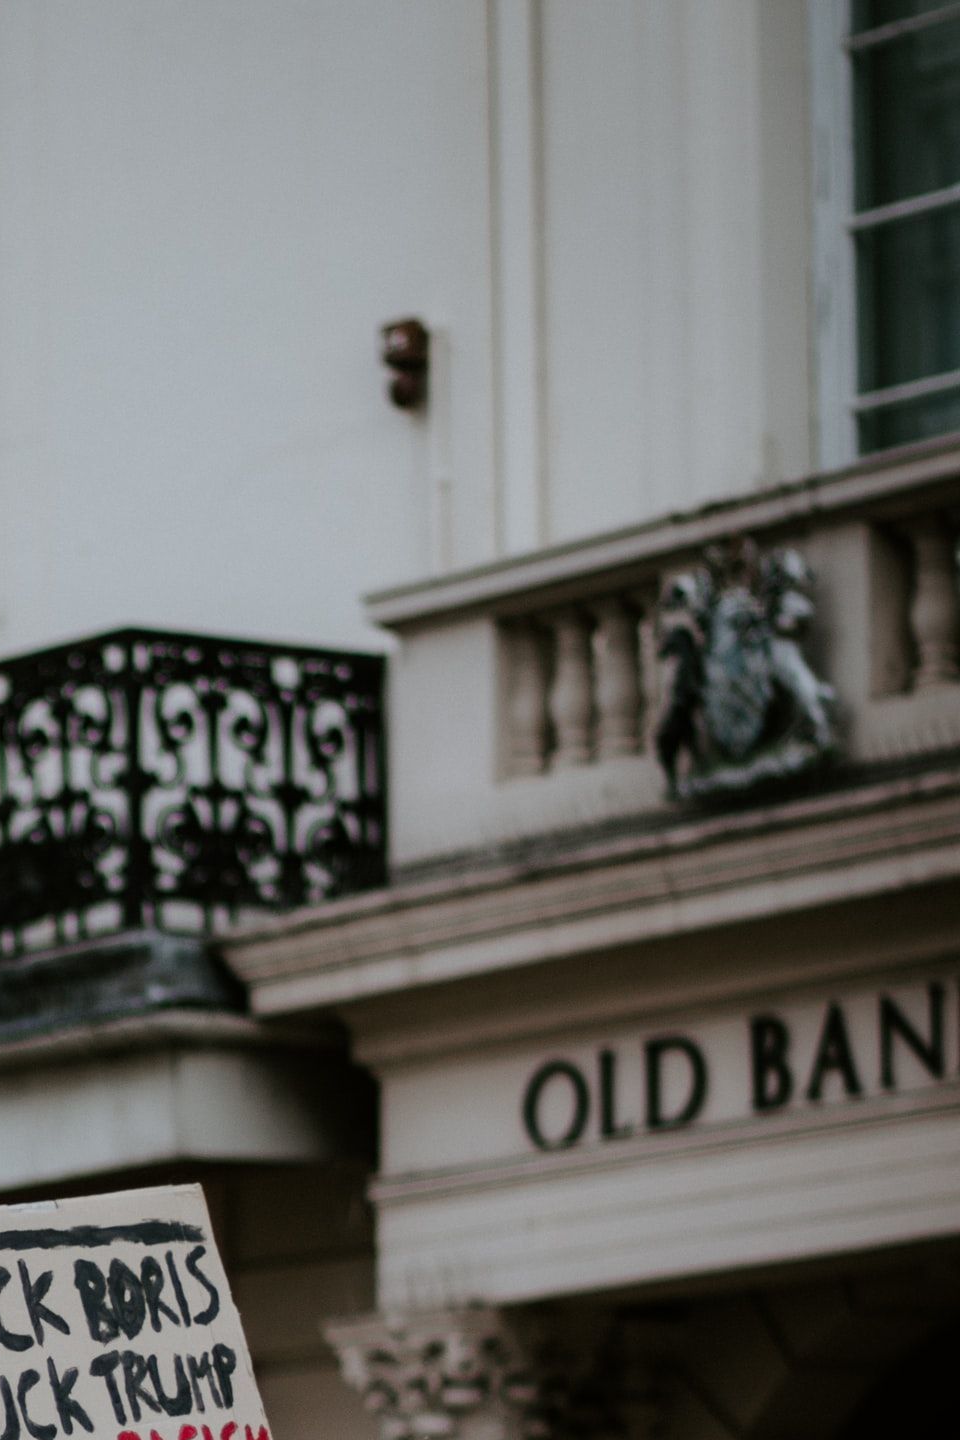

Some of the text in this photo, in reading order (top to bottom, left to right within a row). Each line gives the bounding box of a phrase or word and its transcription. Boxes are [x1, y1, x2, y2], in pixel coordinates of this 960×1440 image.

[524, 982, 960, 1152] OLD BAN
[74, 1245, 220, 1344] BORIS
[90, 1343, 237, 1426] TRUMP
